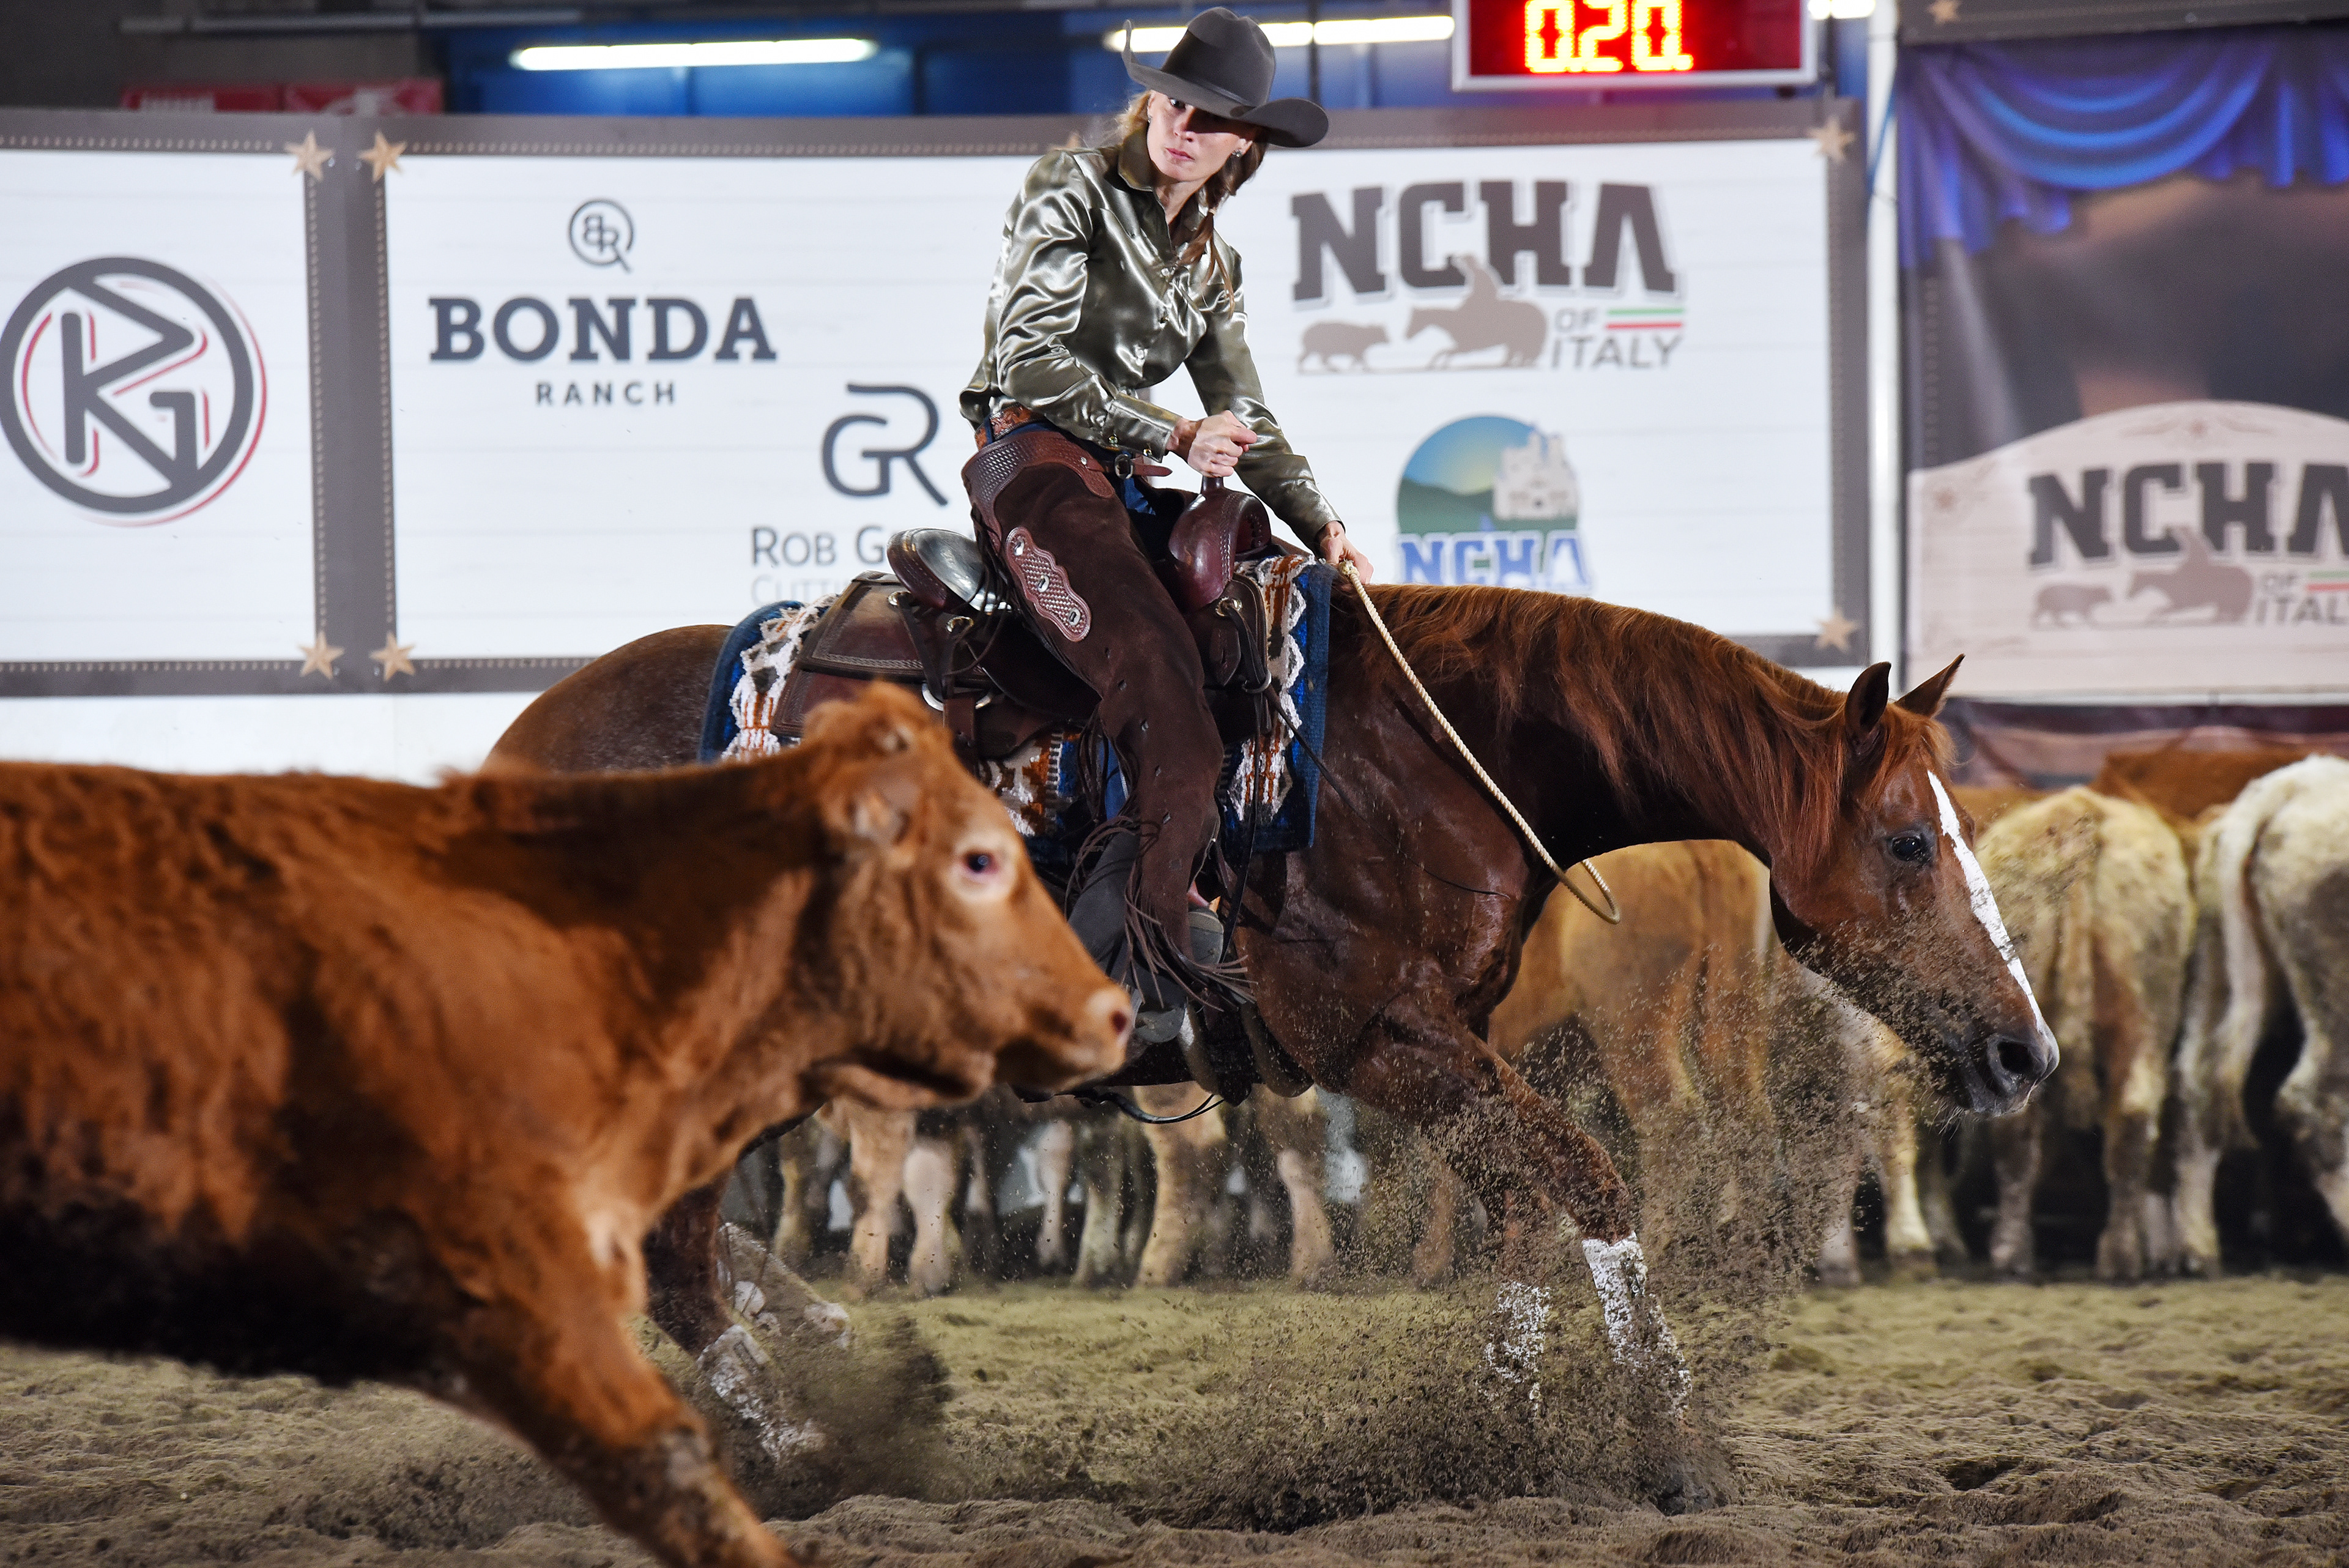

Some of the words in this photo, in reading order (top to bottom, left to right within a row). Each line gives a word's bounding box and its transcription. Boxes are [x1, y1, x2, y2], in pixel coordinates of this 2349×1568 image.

[1291, 179, 1677, 302] NCHA
[428, 297, 777, 363] BONDA
[1555, 307, 1595, 333] OF
[1551, 336, 1683, 369] ITALY
[536, 382, 675, 405] RANCH
[2027, 461, 2349, 566] NCHA
[1401, 538, 1590, 586] NCHA
[2255, 596, 2349, 625] ITAL
